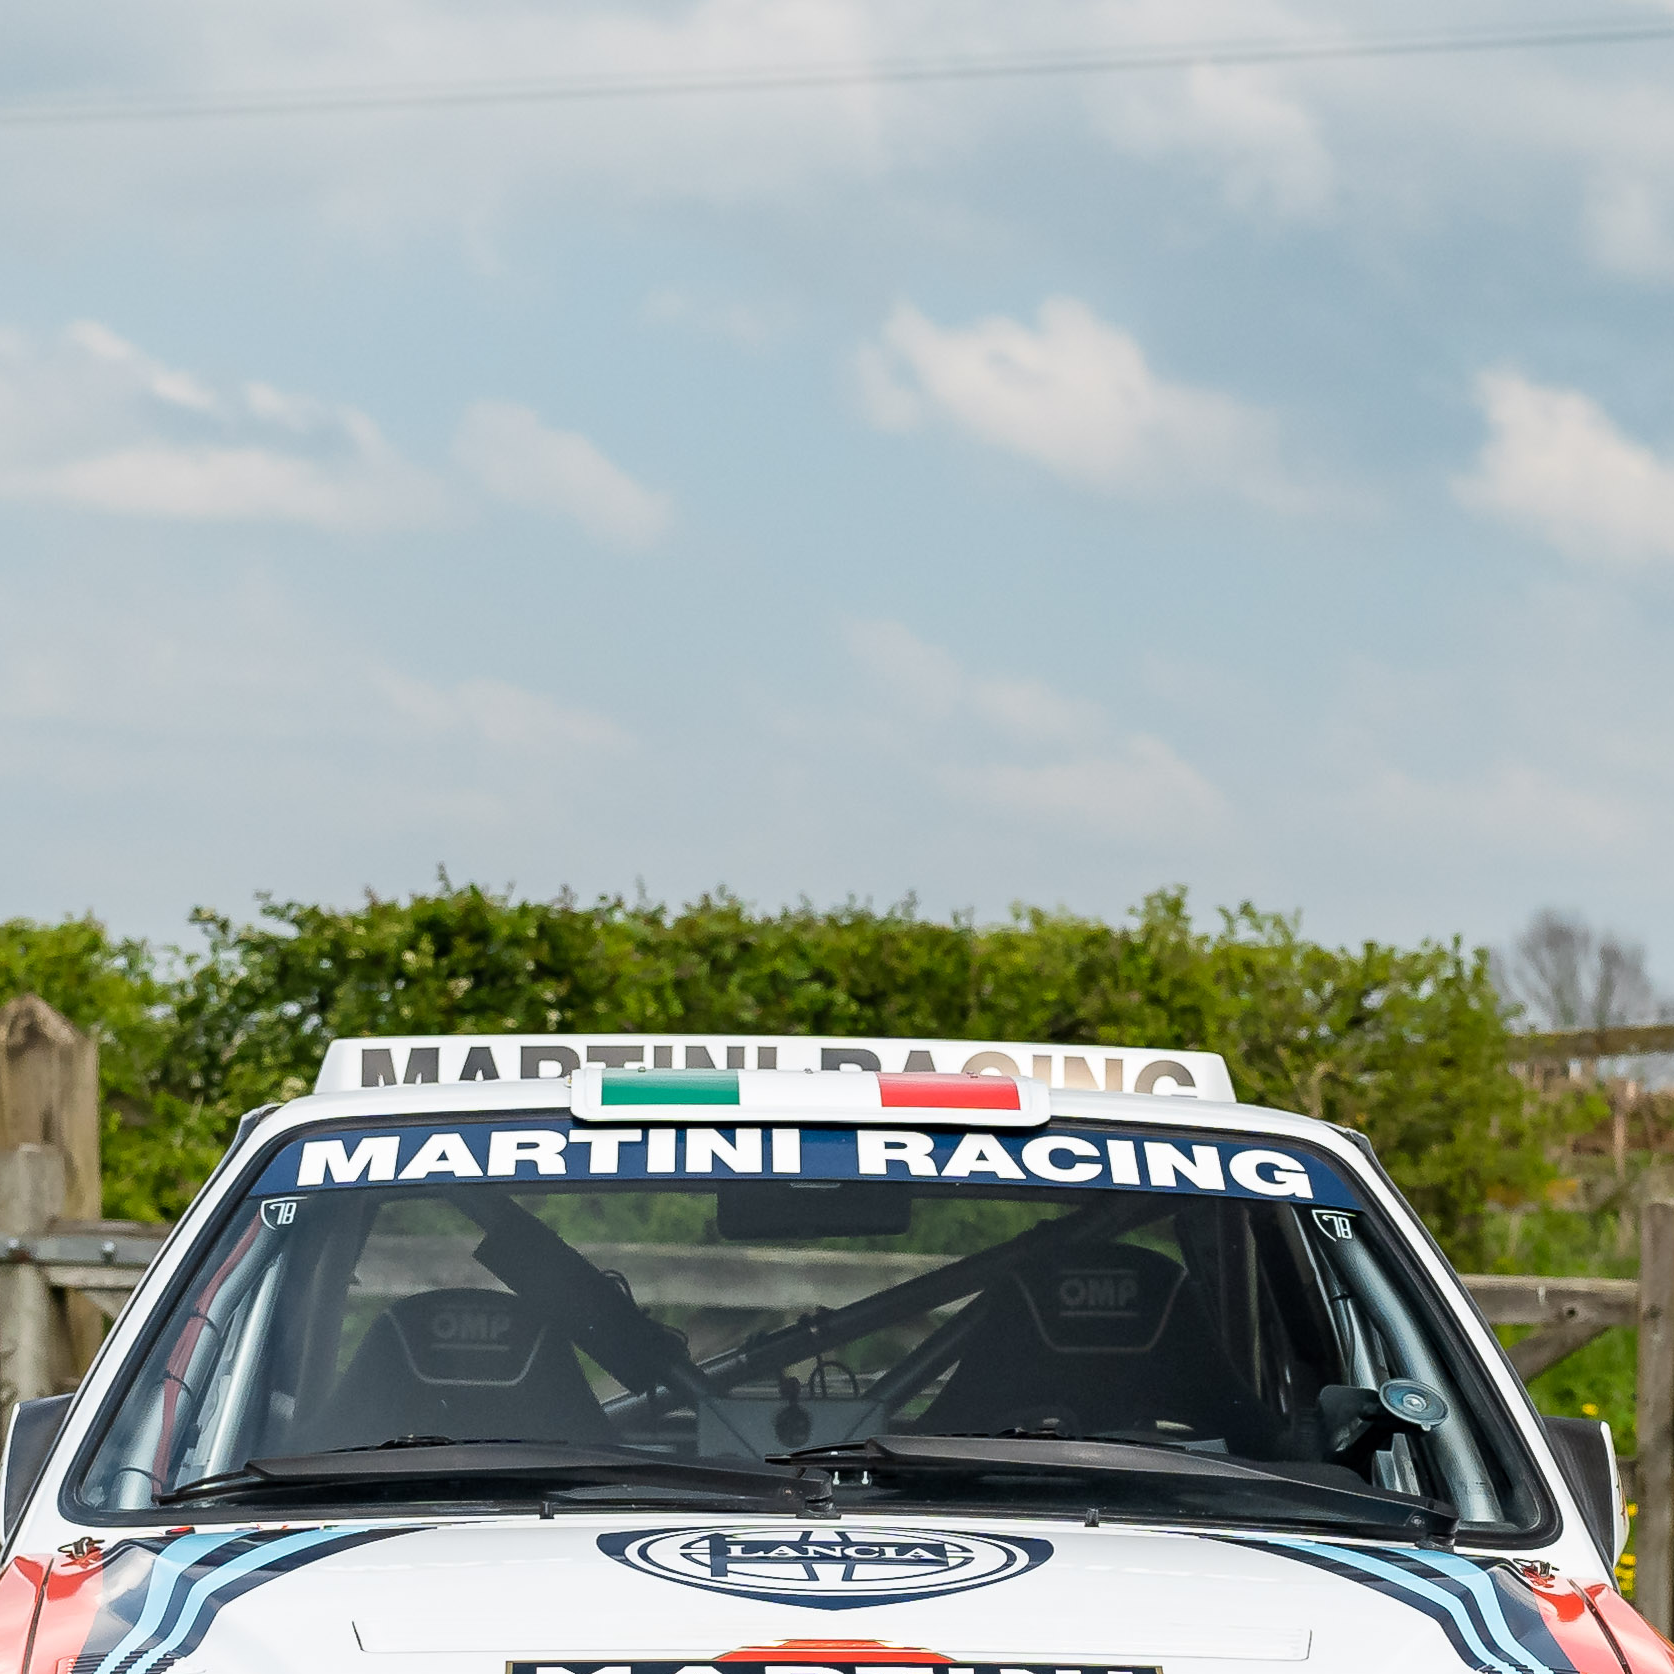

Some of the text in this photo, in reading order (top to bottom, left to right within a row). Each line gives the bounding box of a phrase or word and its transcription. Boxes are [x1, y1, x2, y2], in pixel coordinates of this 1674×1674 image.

[296, 1127, 1314, 1200] MARTINI RACING
[1059, 1277, 1139, 1307] OMP
[430, 1311, 510, 1340] OMP
[726, 1544, 939, 1560] LANCIA
